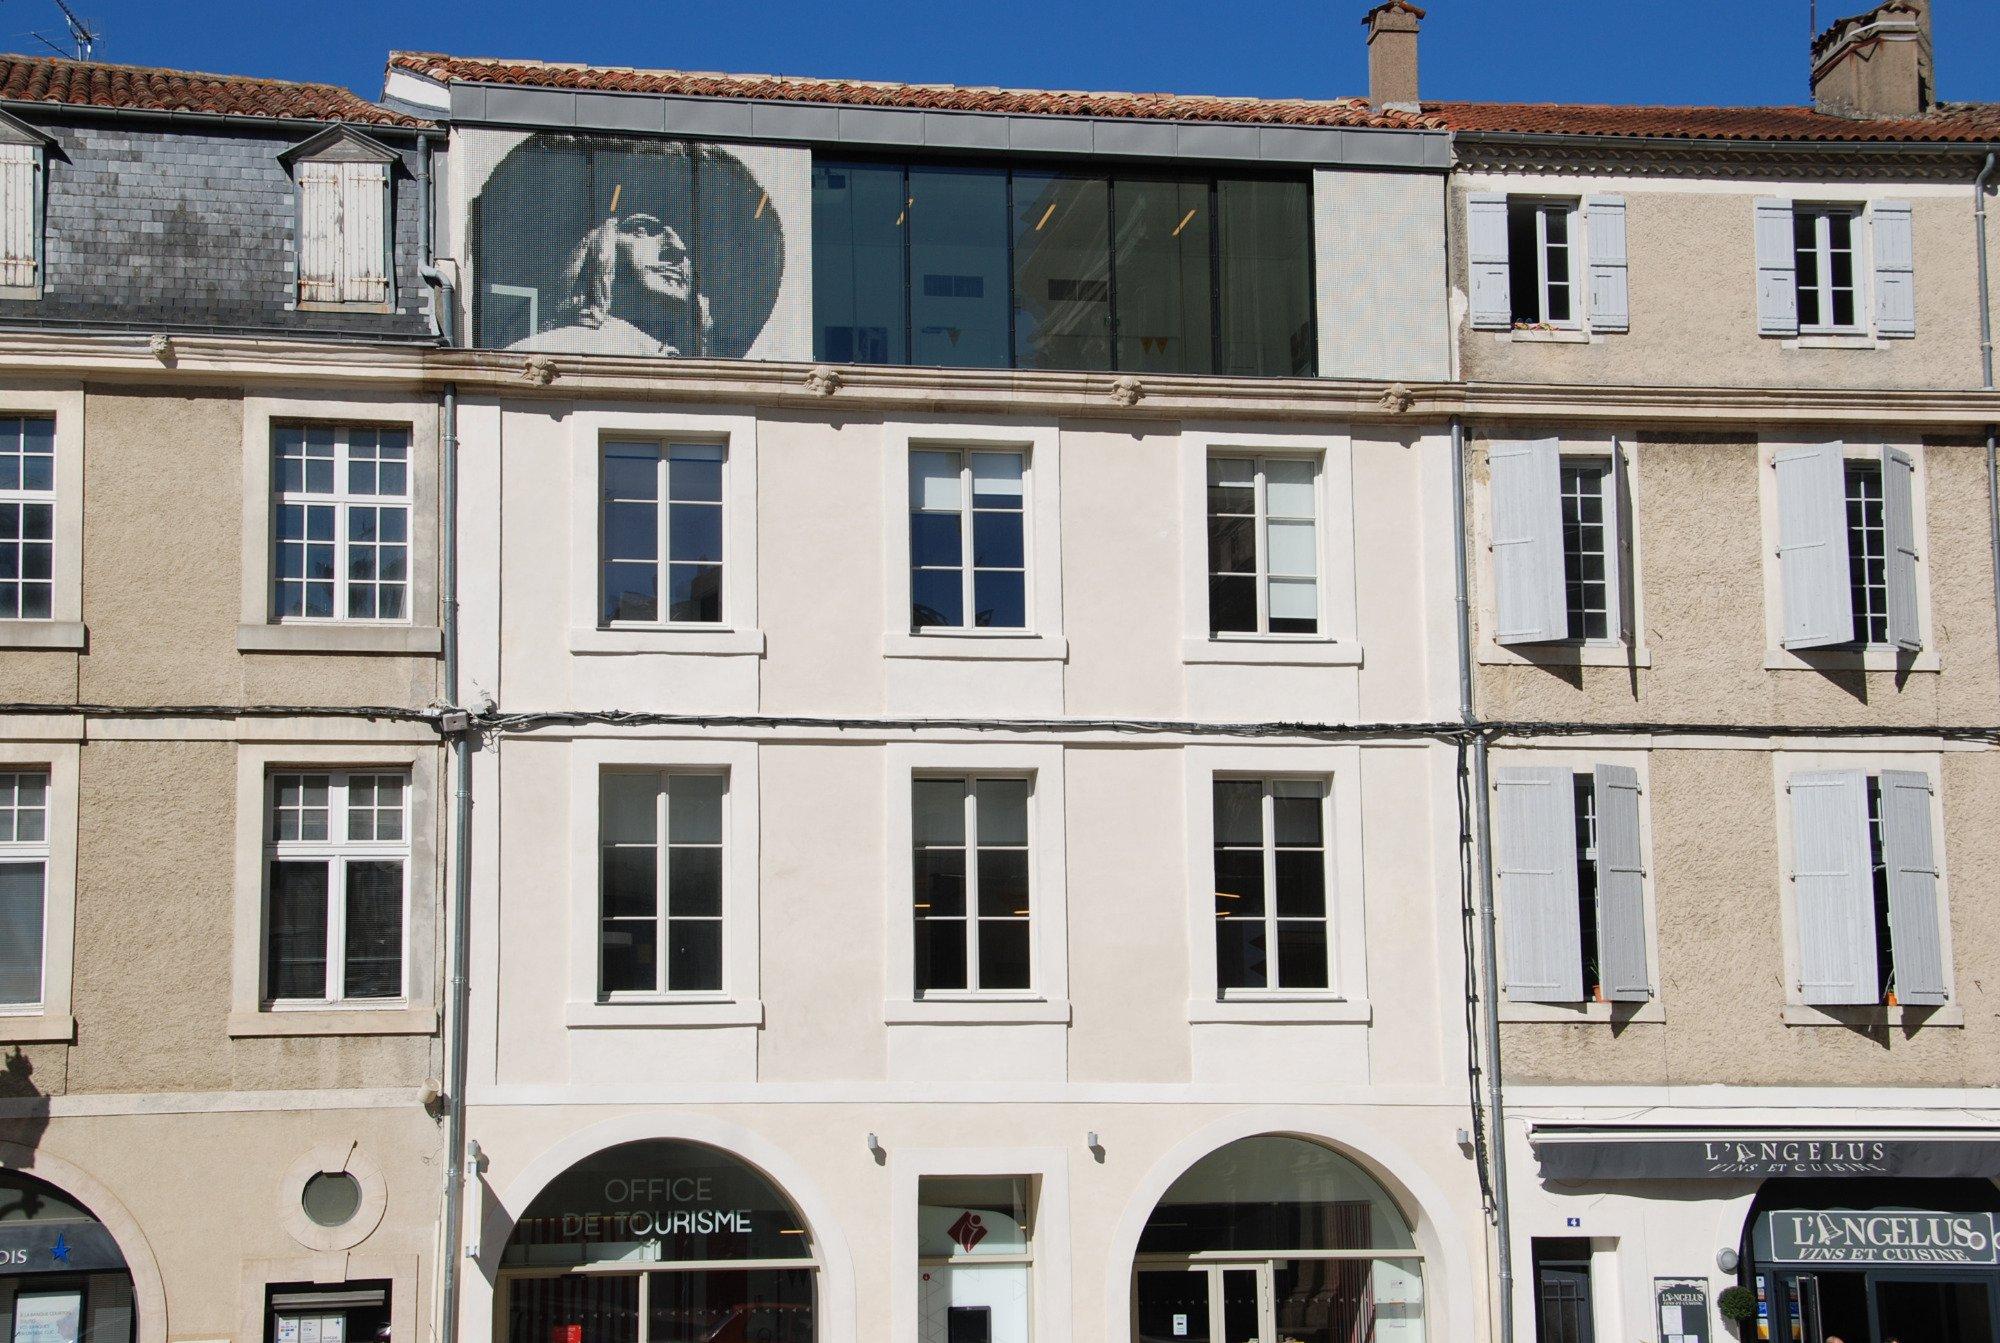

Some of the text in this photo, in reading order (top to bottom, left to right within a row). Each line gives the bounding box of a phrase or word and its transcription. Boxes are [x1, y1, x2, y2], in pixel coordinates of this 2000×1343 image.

[1708, 1163, 1887, 1172] VINS ET CUISINE
[605, 1177, 713, 1202] OFFICE
[562, 1209, 753, 1236] DE TOURISME
[1570, 1218, 1578, 1227] 4
[1798, 1248, 1971, 1262] VINS ET CUISINE
